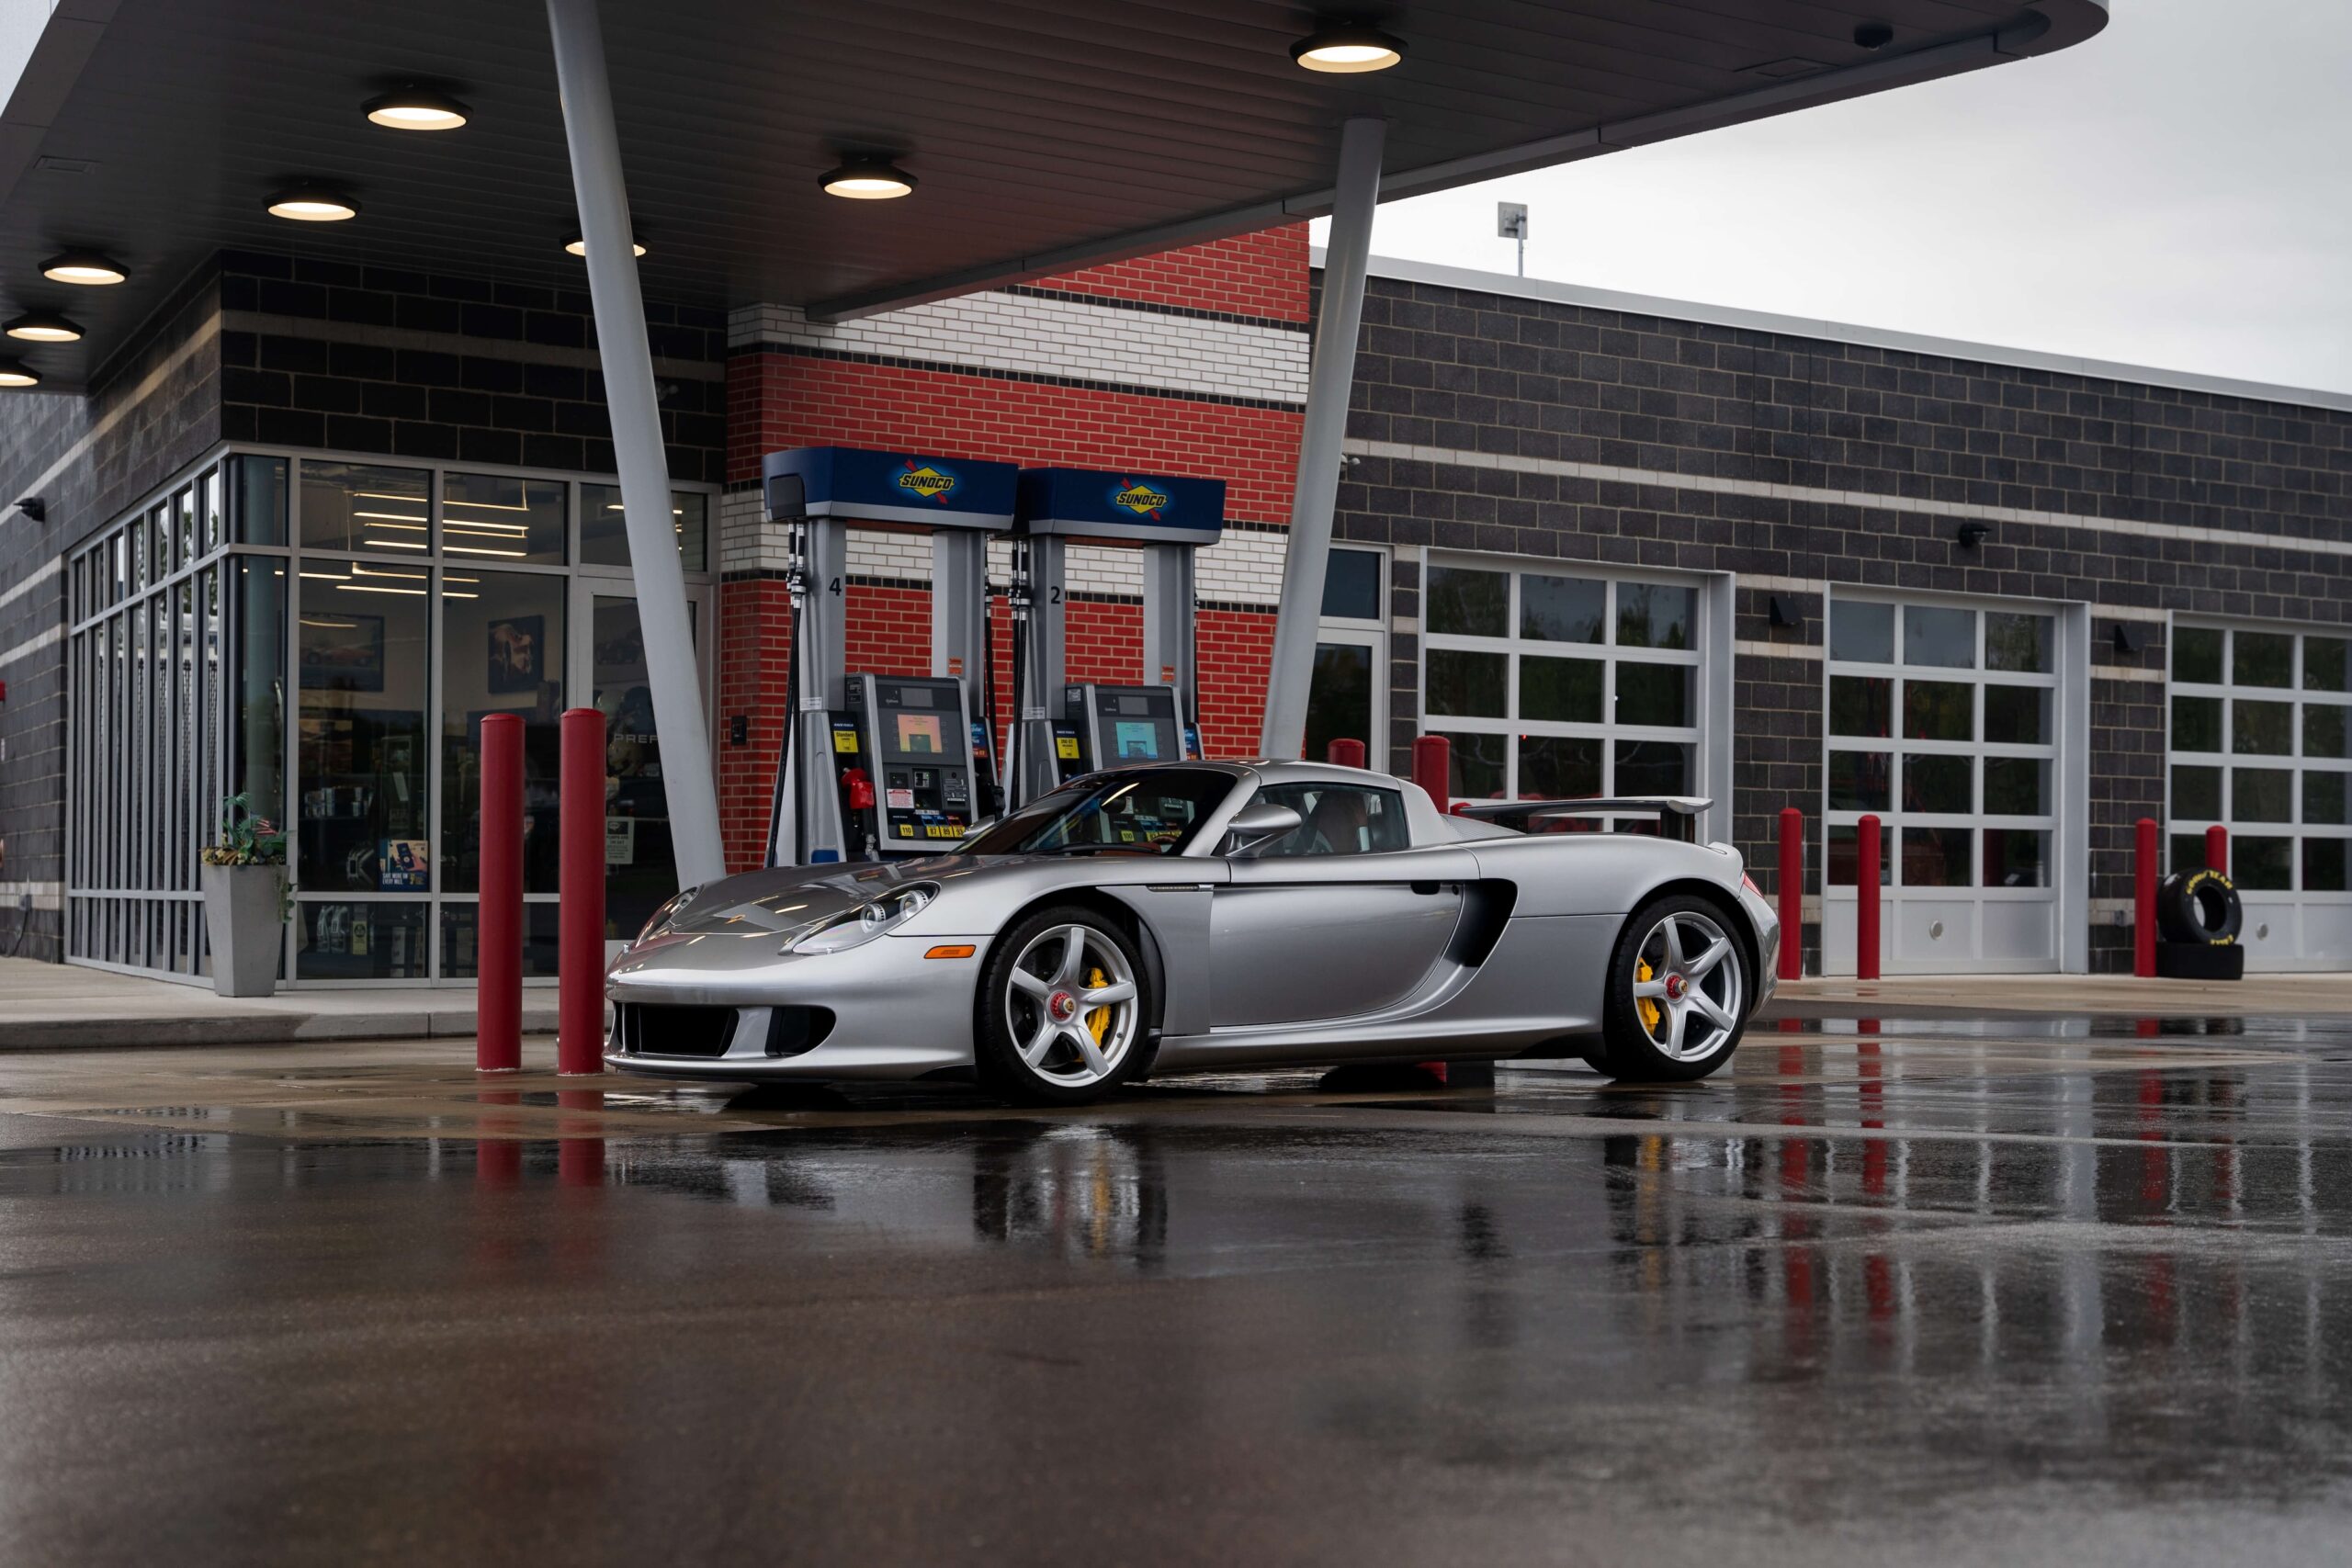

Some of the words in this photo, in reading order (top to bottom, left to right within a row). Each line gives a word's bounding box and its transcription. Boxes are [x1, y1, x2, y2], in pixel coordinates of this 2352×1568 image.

[901, 475, 952, 489] SUNOCO
[1118, 493, 1165, 506] SUNOCO
[829, 577, 842, 596] 4
[1050, 586, 1061, 604] 2
[614, 733, 658, 744] PREF
